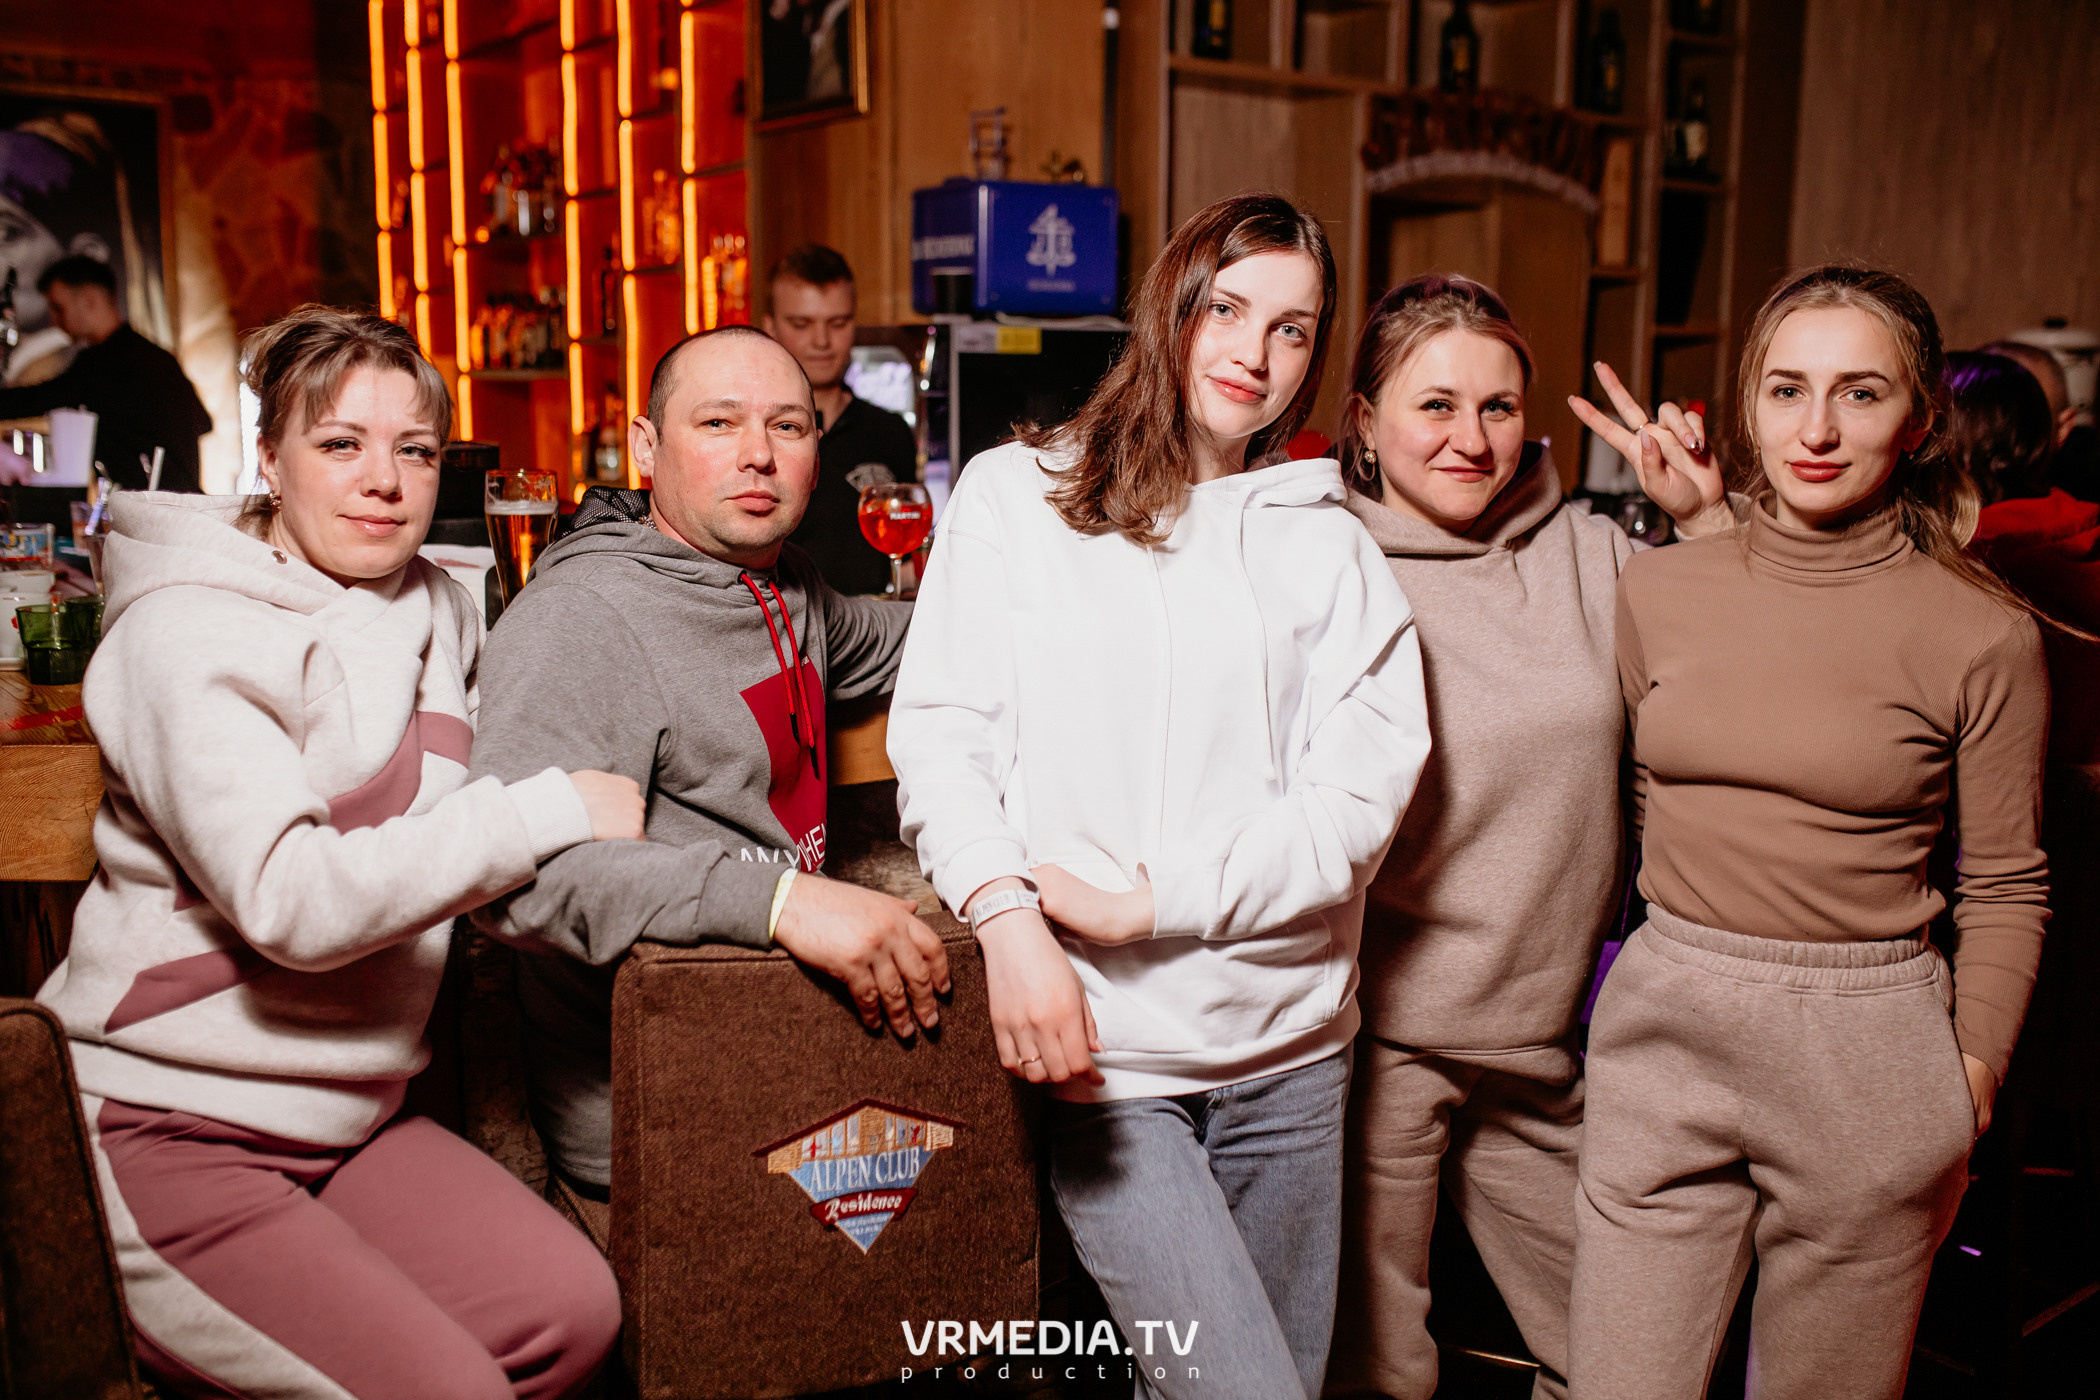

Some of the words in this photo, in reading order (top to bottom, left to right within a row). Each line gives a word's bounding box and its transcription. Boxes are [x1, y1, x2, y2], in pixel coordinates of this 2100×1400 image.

[809, 1154, 871, 1193] ALPEN
[875, 1146, 921, 1184] CLUB
[825, 1192, 903, 1223] Residence
